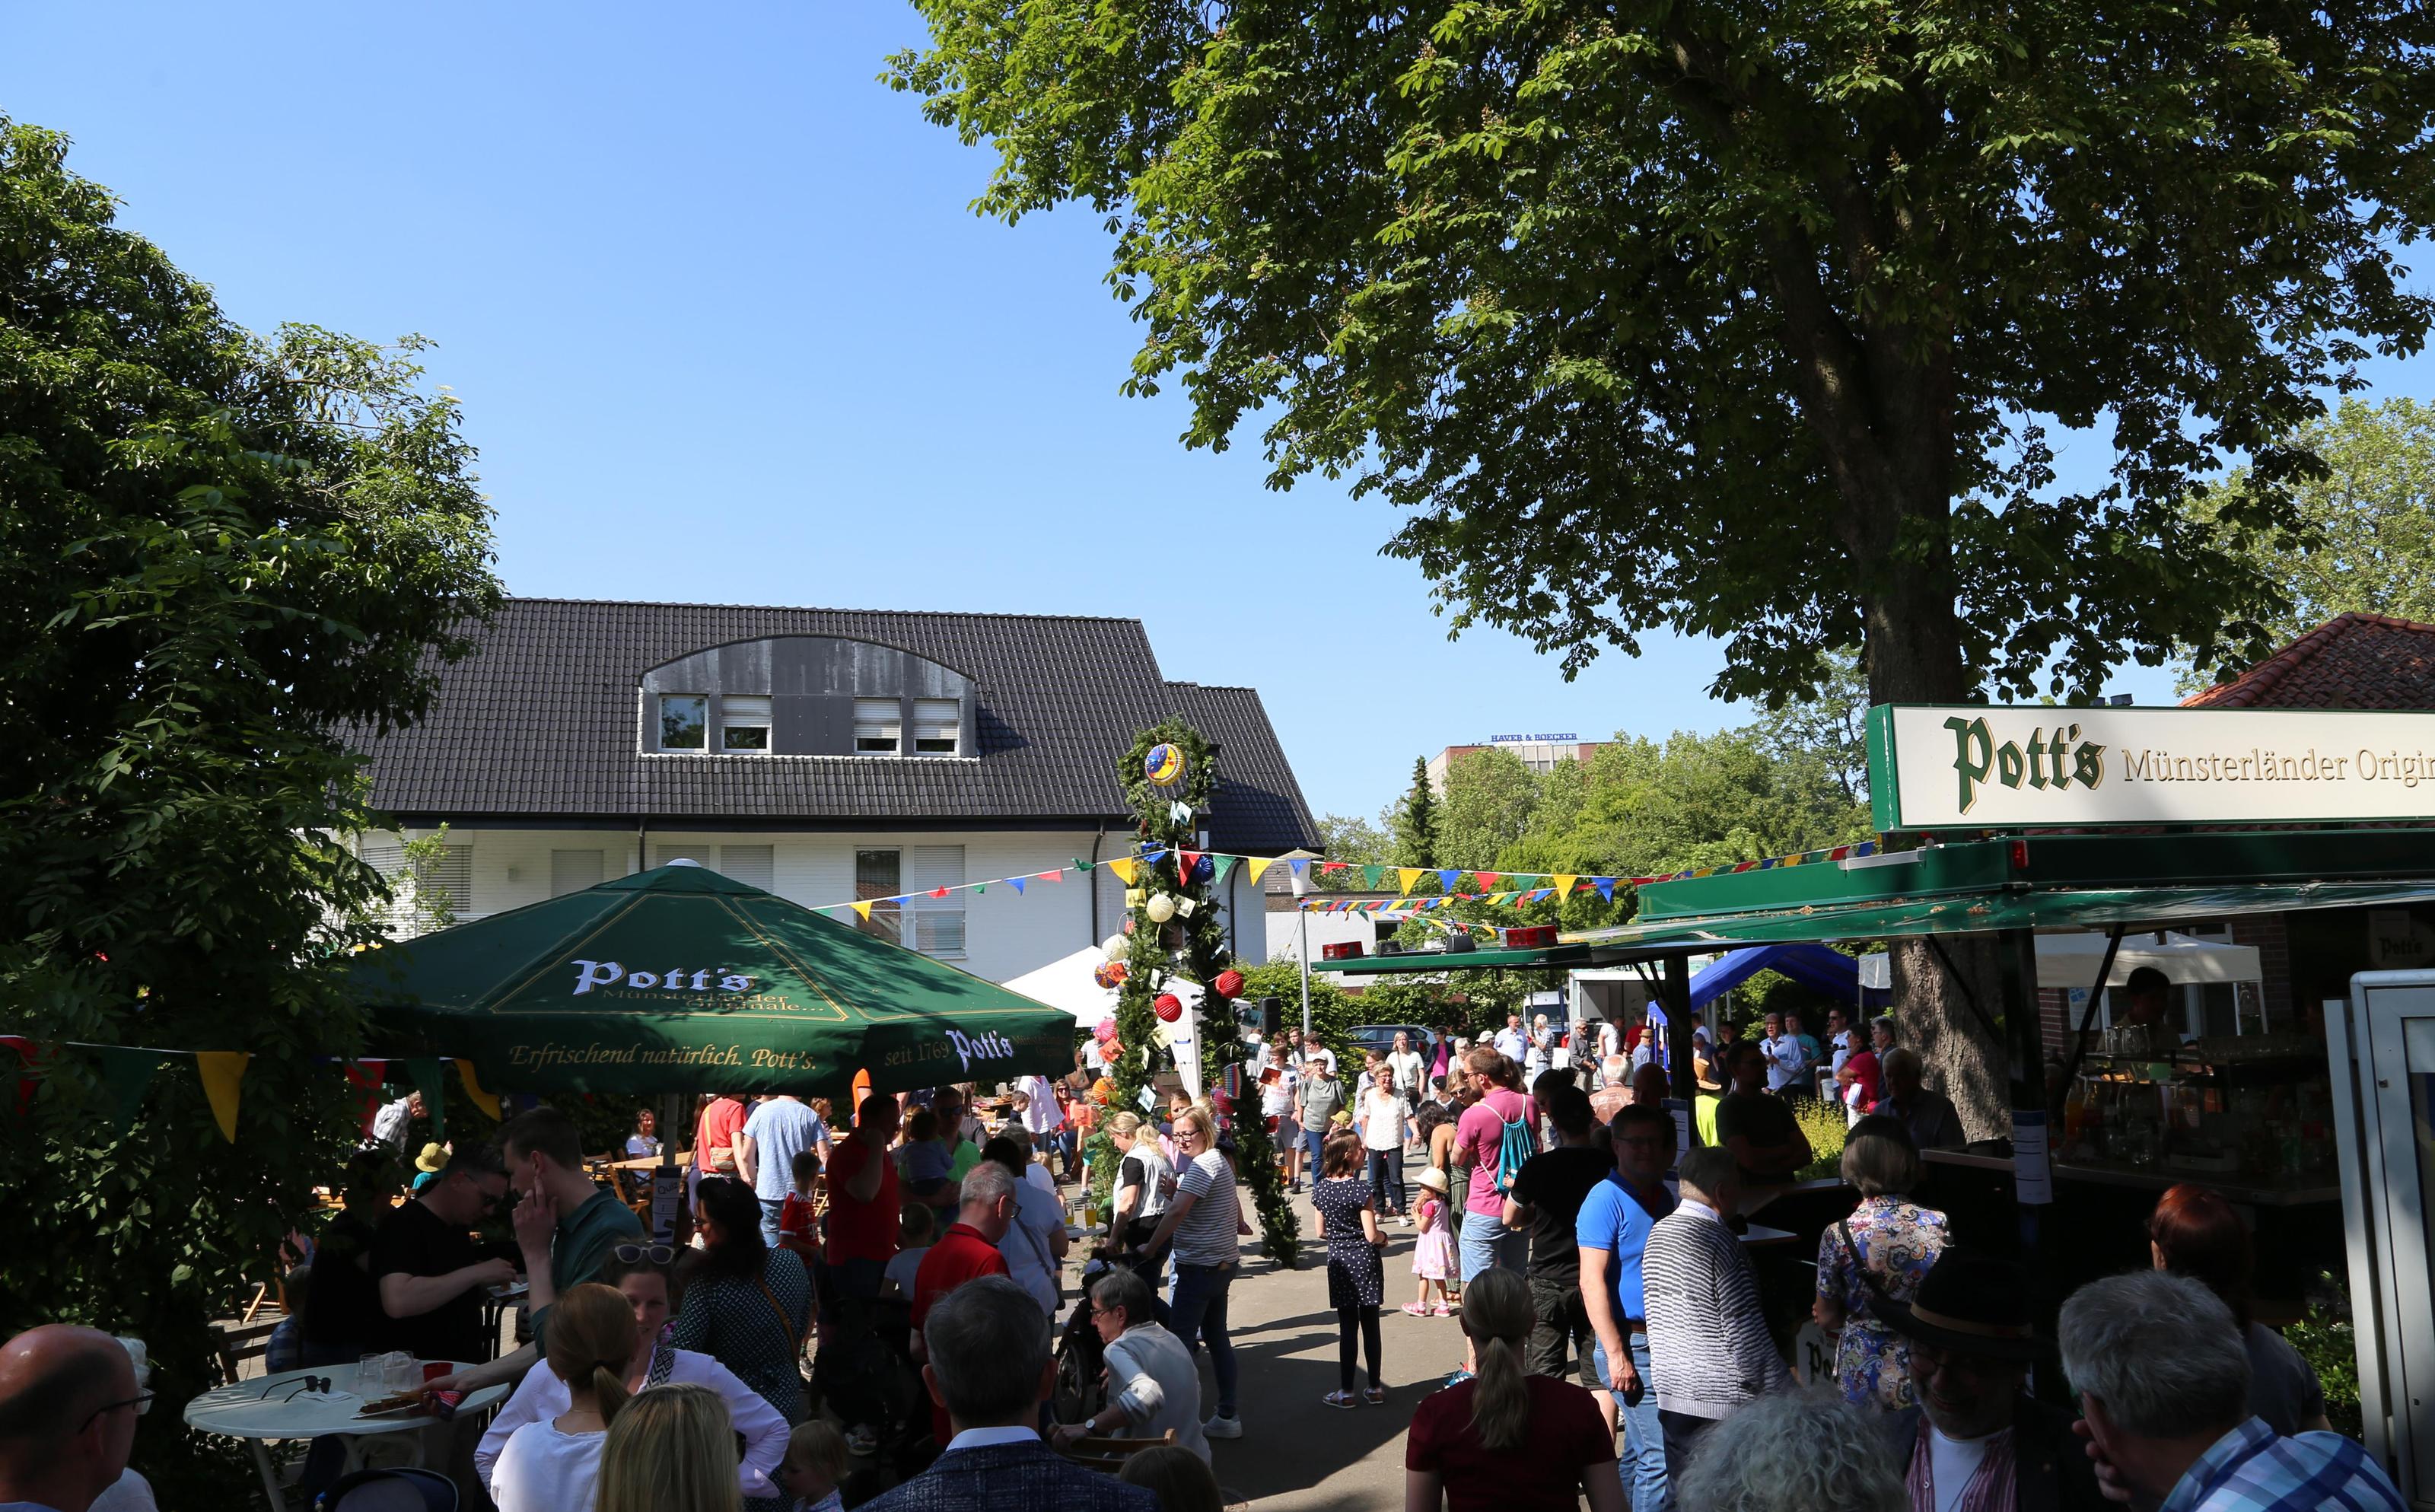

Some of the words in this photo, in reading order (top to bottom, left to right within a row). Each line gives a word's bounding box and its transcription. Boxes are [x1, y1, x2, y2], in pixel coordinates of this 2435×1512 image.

[1491, 734, 1522, 743] HAVER
[1535, 733, 1577, 741] BOECKER
[1943, 716, 2107, 816] Pott's
[2121, 747, 2347, 782] Münsterländer
[2378, 937, 2424, 960] Pott's
[571, 959, 759, 996] Pott's
[509, 1042, 641, 1073] Erfrischend
[640, 1044, 743, 1067] natürlich.
[750, 1048, 817, 1071] Pott's.
[884, 1046, 913, 1067] seit
[917, 1041, 950, 1062] 1769
[945, 1028, 1015, 1074] Pott's
